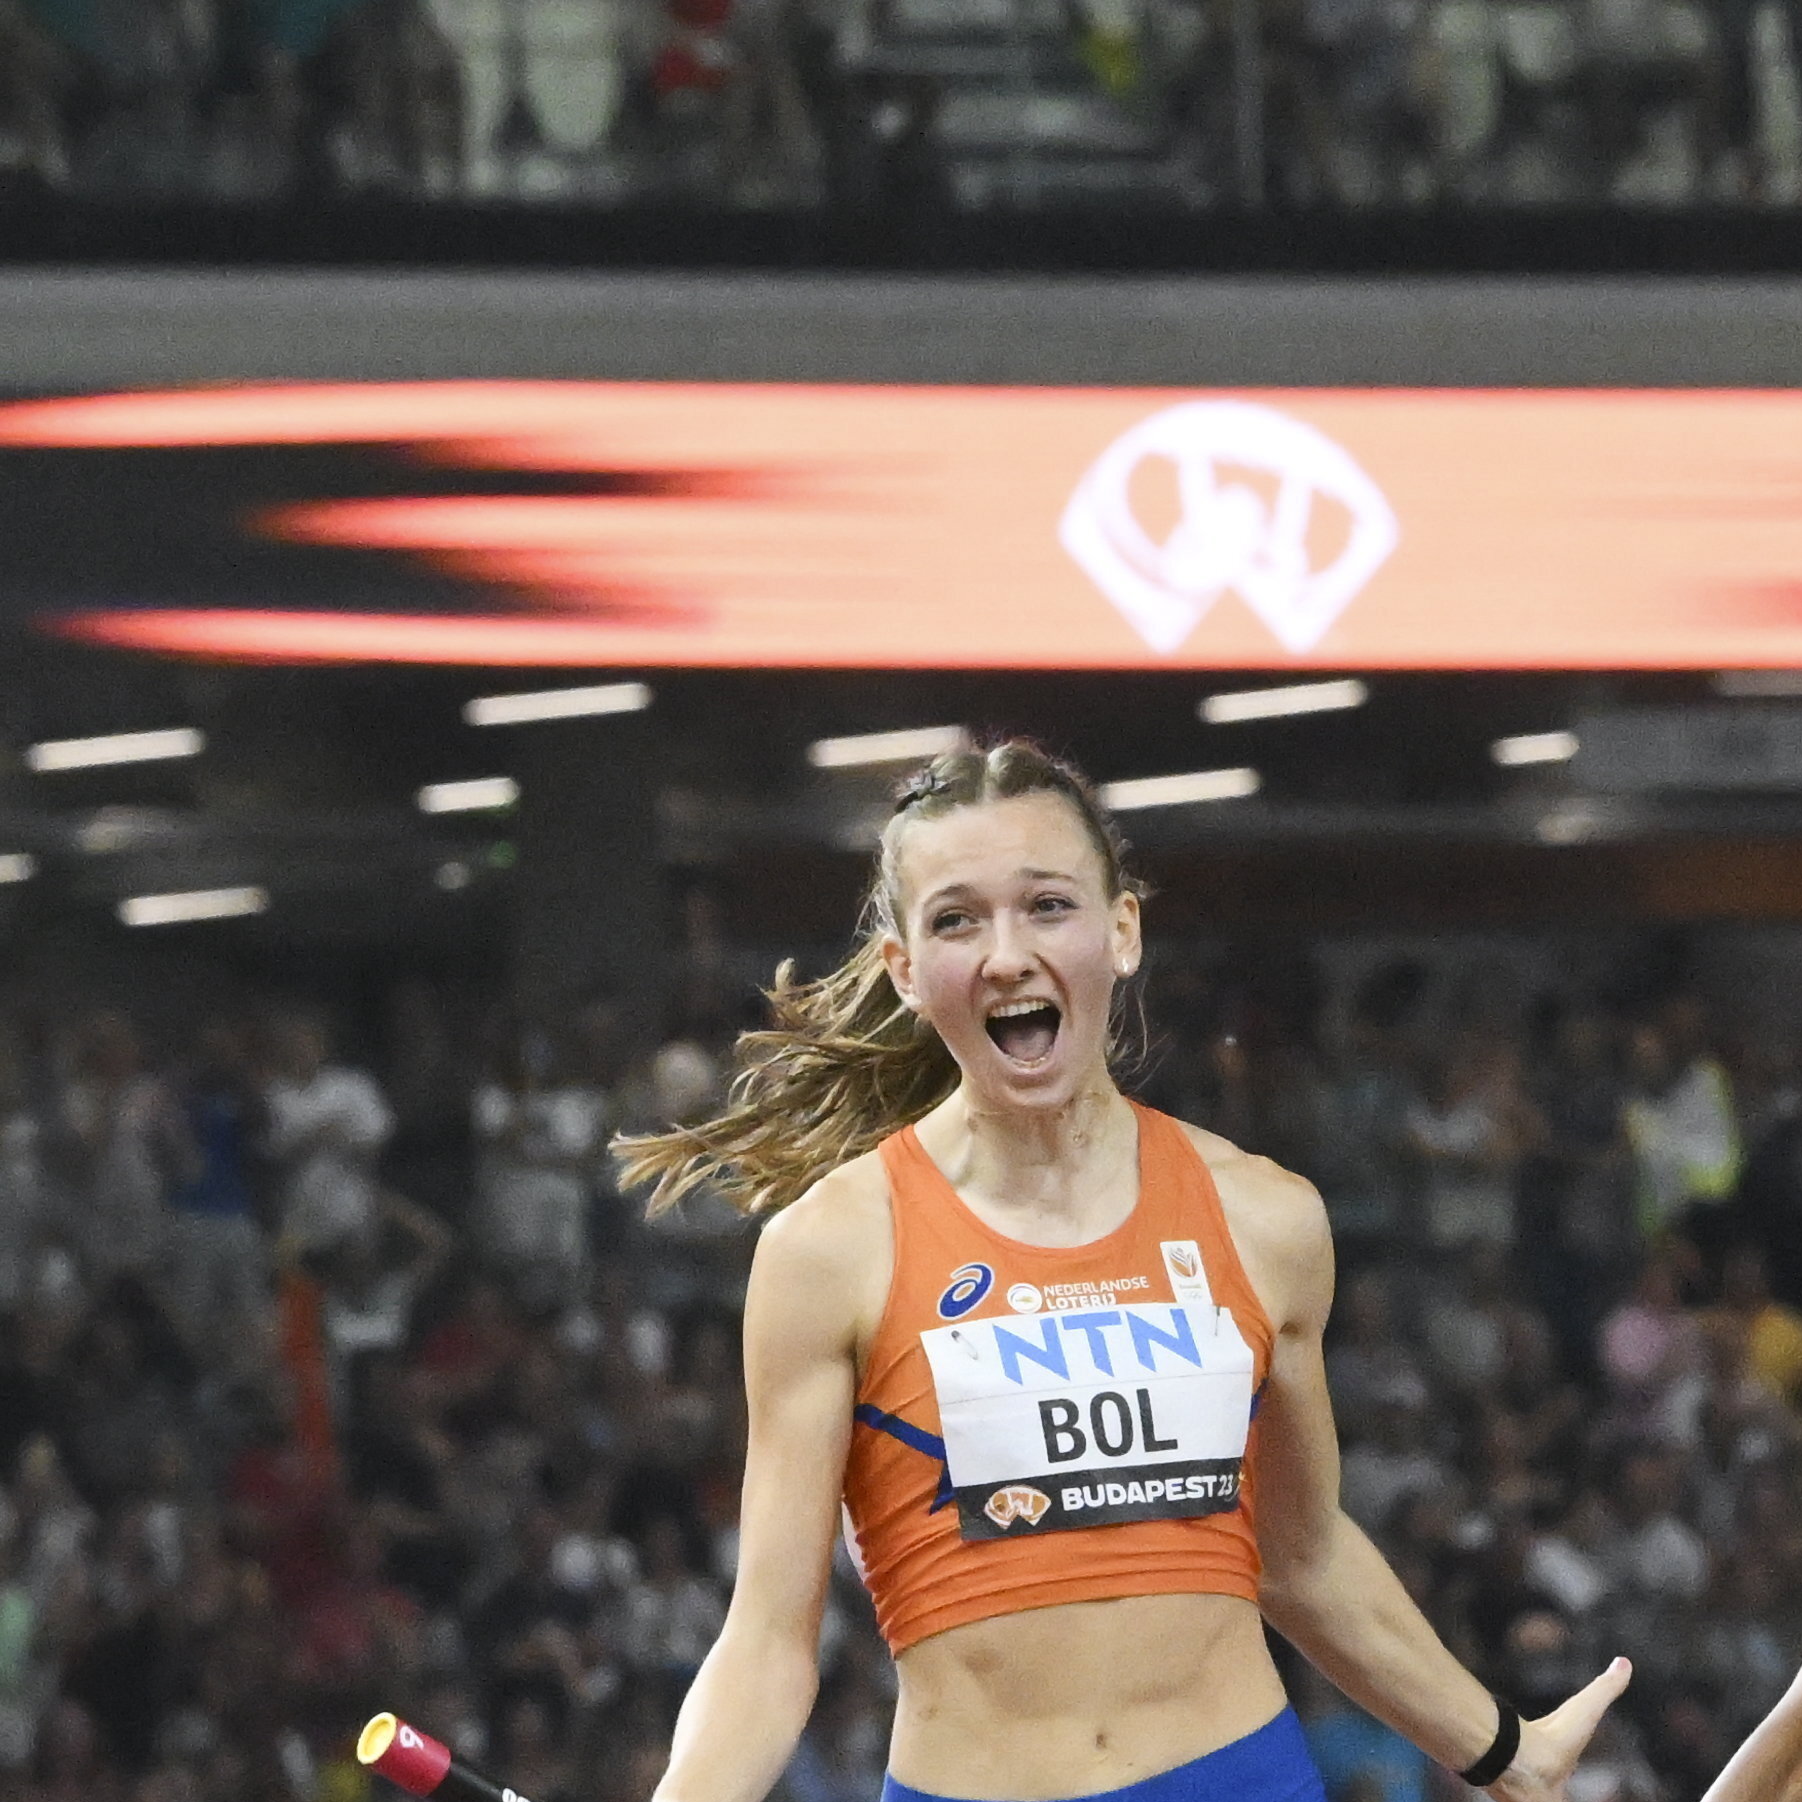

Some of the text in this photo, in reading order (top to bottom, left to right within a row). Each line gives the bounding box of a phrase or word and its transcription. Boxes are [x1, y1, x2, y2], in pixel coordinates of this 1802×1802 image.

[1043, 1275, 1150, 1297] NEDERLANDSE
[992, 1308, 1203, 1386] NTN
[1038, 1388, 1179, 1463] BOL
